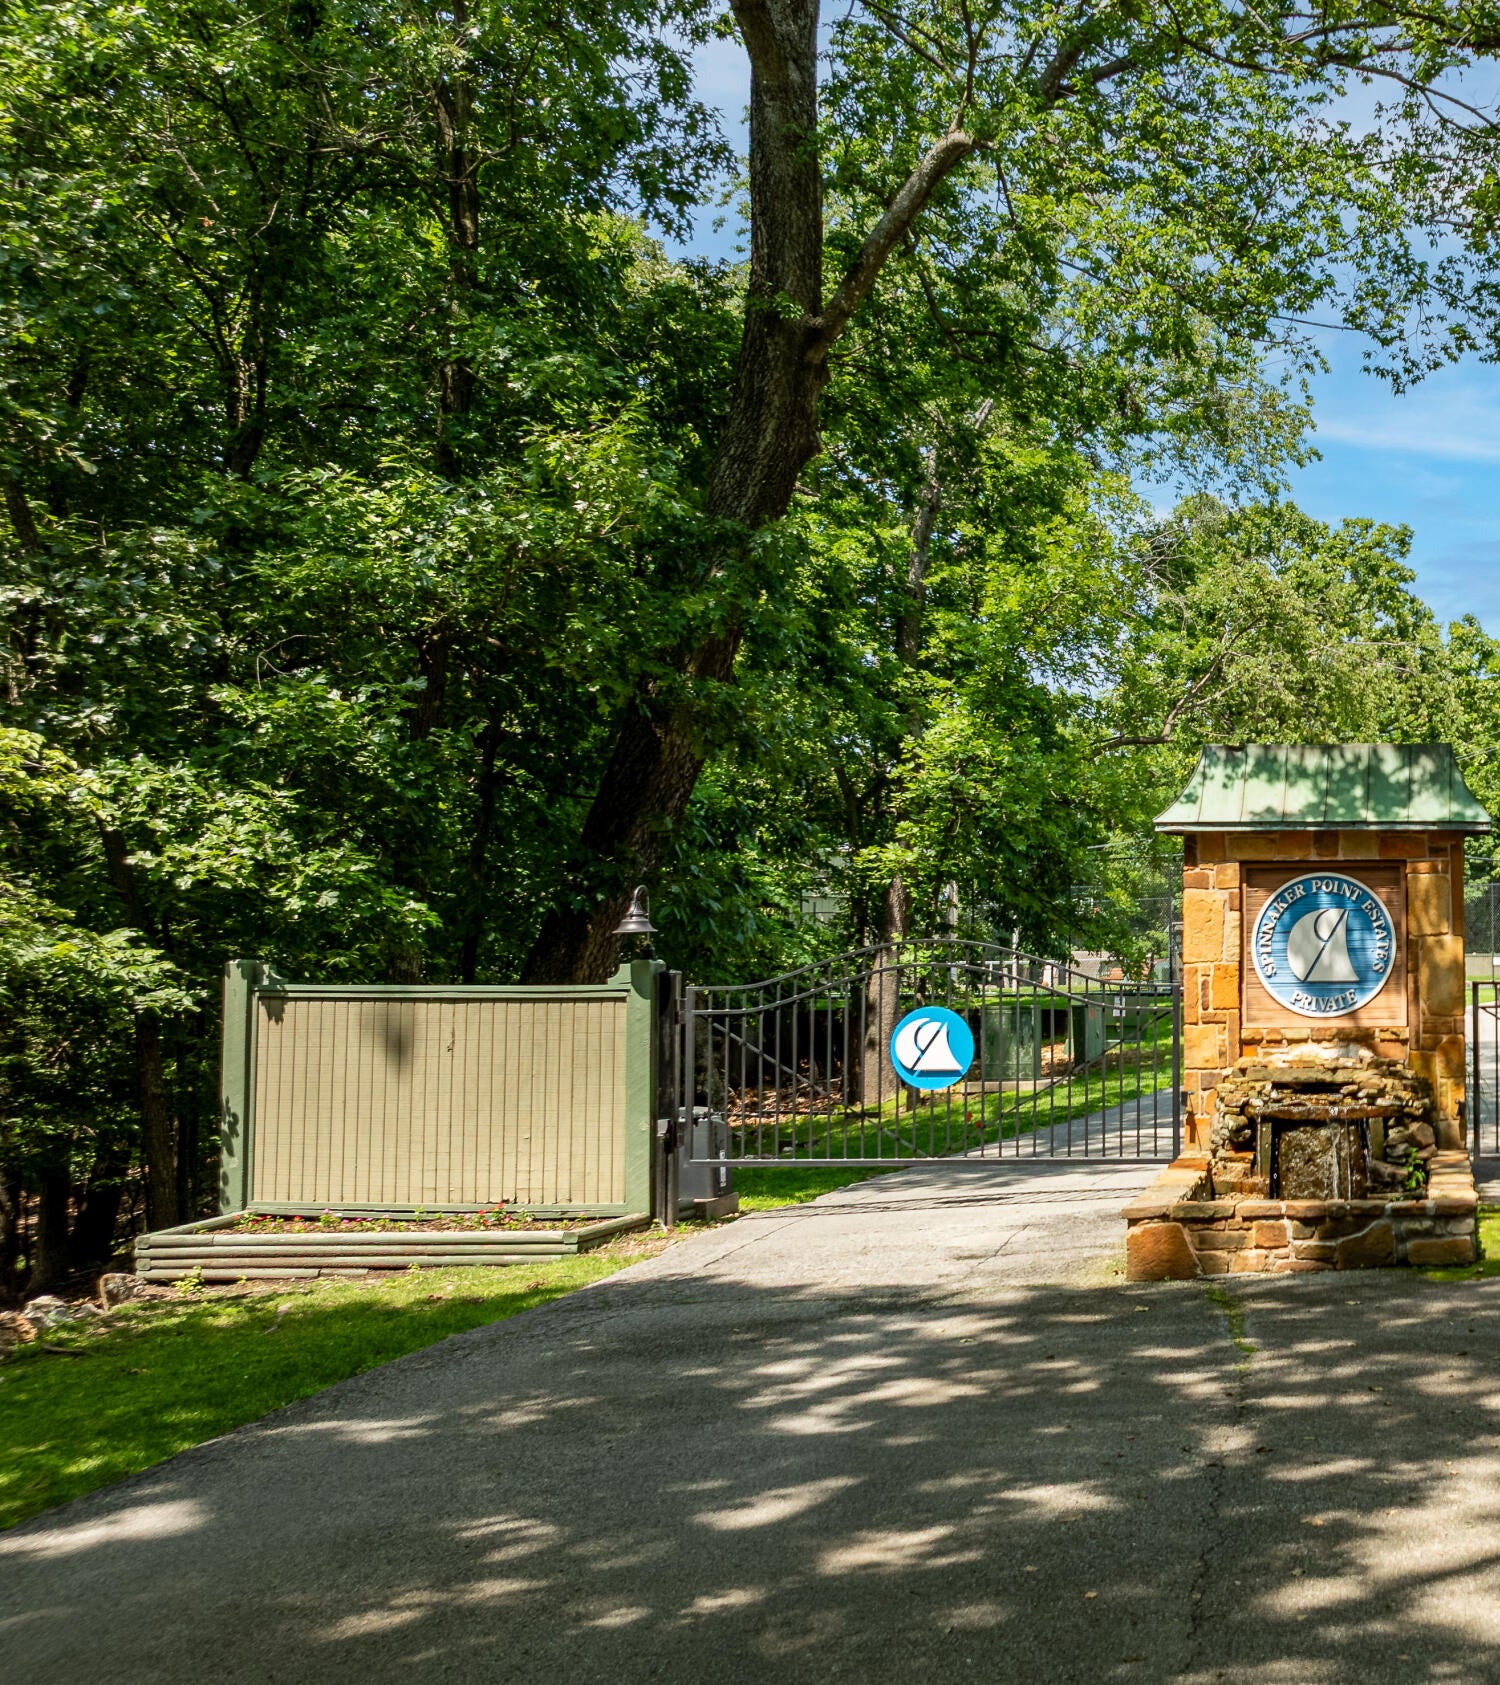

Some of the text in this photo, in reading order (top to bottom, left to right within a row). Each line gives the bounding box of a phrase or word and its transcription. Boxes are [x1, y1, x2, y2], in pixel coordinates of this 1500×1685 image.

[1260, 879, 1390, 978] SPINNAKER POINT ESTATES
[1290, 988, 1358, 1012] PRIVATE
